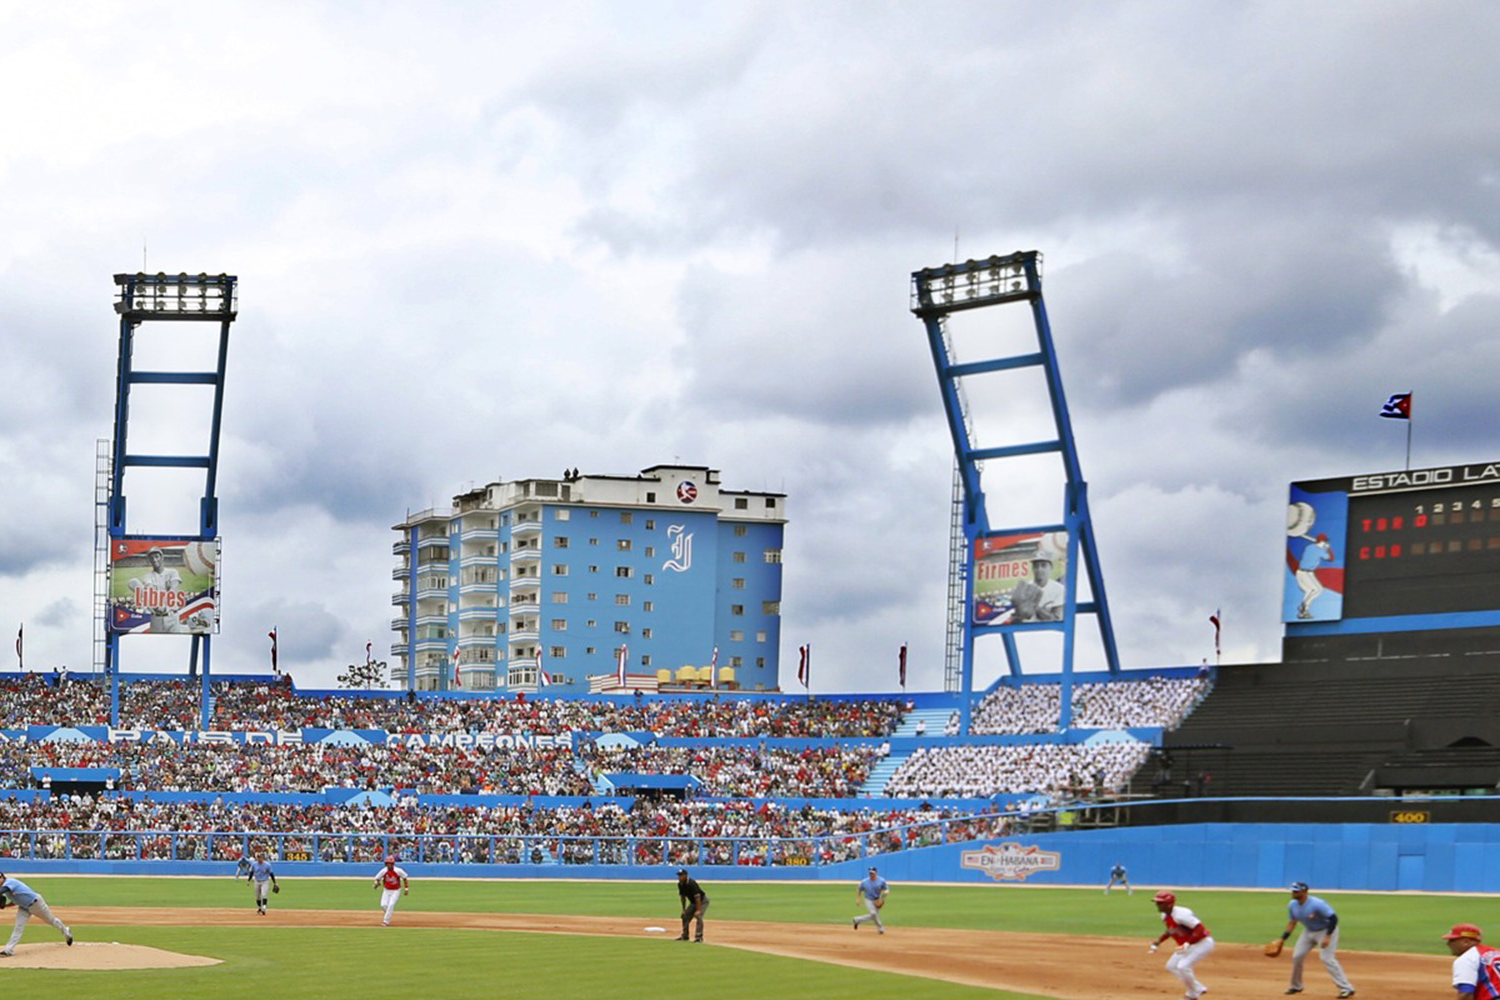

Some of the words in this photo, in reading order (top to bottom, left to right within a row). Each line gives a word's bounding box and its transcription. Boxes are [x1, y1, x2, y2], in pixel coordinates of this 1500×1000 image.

[1352, 469, 1452, 491] ESTADIO
[1463, 464, 1500, 481] LA
[1415, 505, 1424, 514] 1
[1433, 503, 1444, 513] 2
[1452, 501, 1463, 511] 3
[1471, 500, 1481, 509] 4
[977, 560, 1029, 580] Firmes
[135, 585, 186, 608] Libres
[1395, 812, 1425, 823] 400
[287, 852, 308, 861] 345
[786, 857, 807, 866] 380
[1001, 855, 1038, 866] HABANA
